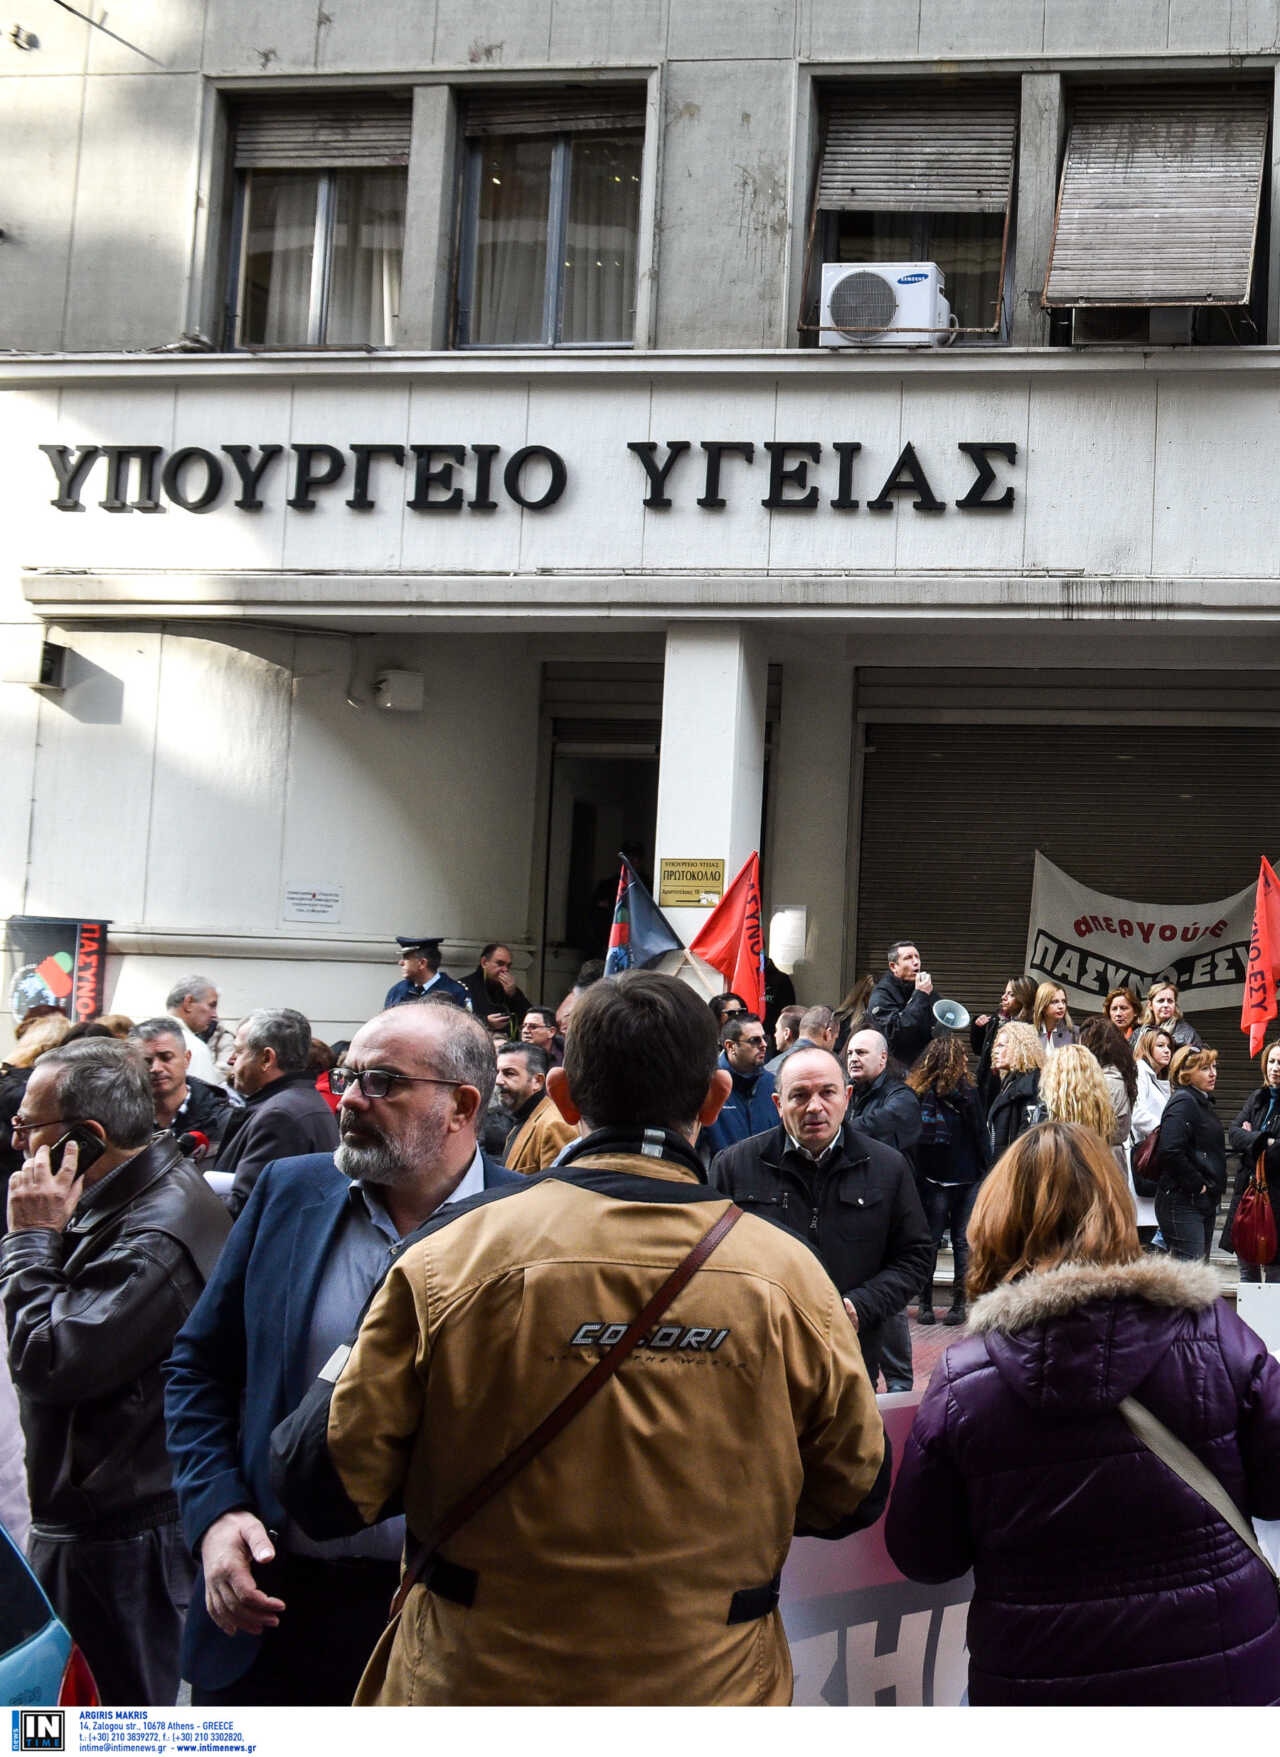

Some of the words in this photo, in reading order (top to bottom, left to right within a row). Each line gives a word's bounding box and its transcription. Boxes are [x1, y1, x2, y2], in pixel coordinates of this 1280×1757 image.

[39, 444, 568, 512] ΥΠΟΥΡΓΕΙΟ
[628, 441, 1017, 510] ΥΓΕΙΑΣ
[663, 870, 721, 881] ΠΡΩΤΟΚΟΛΛΟ
